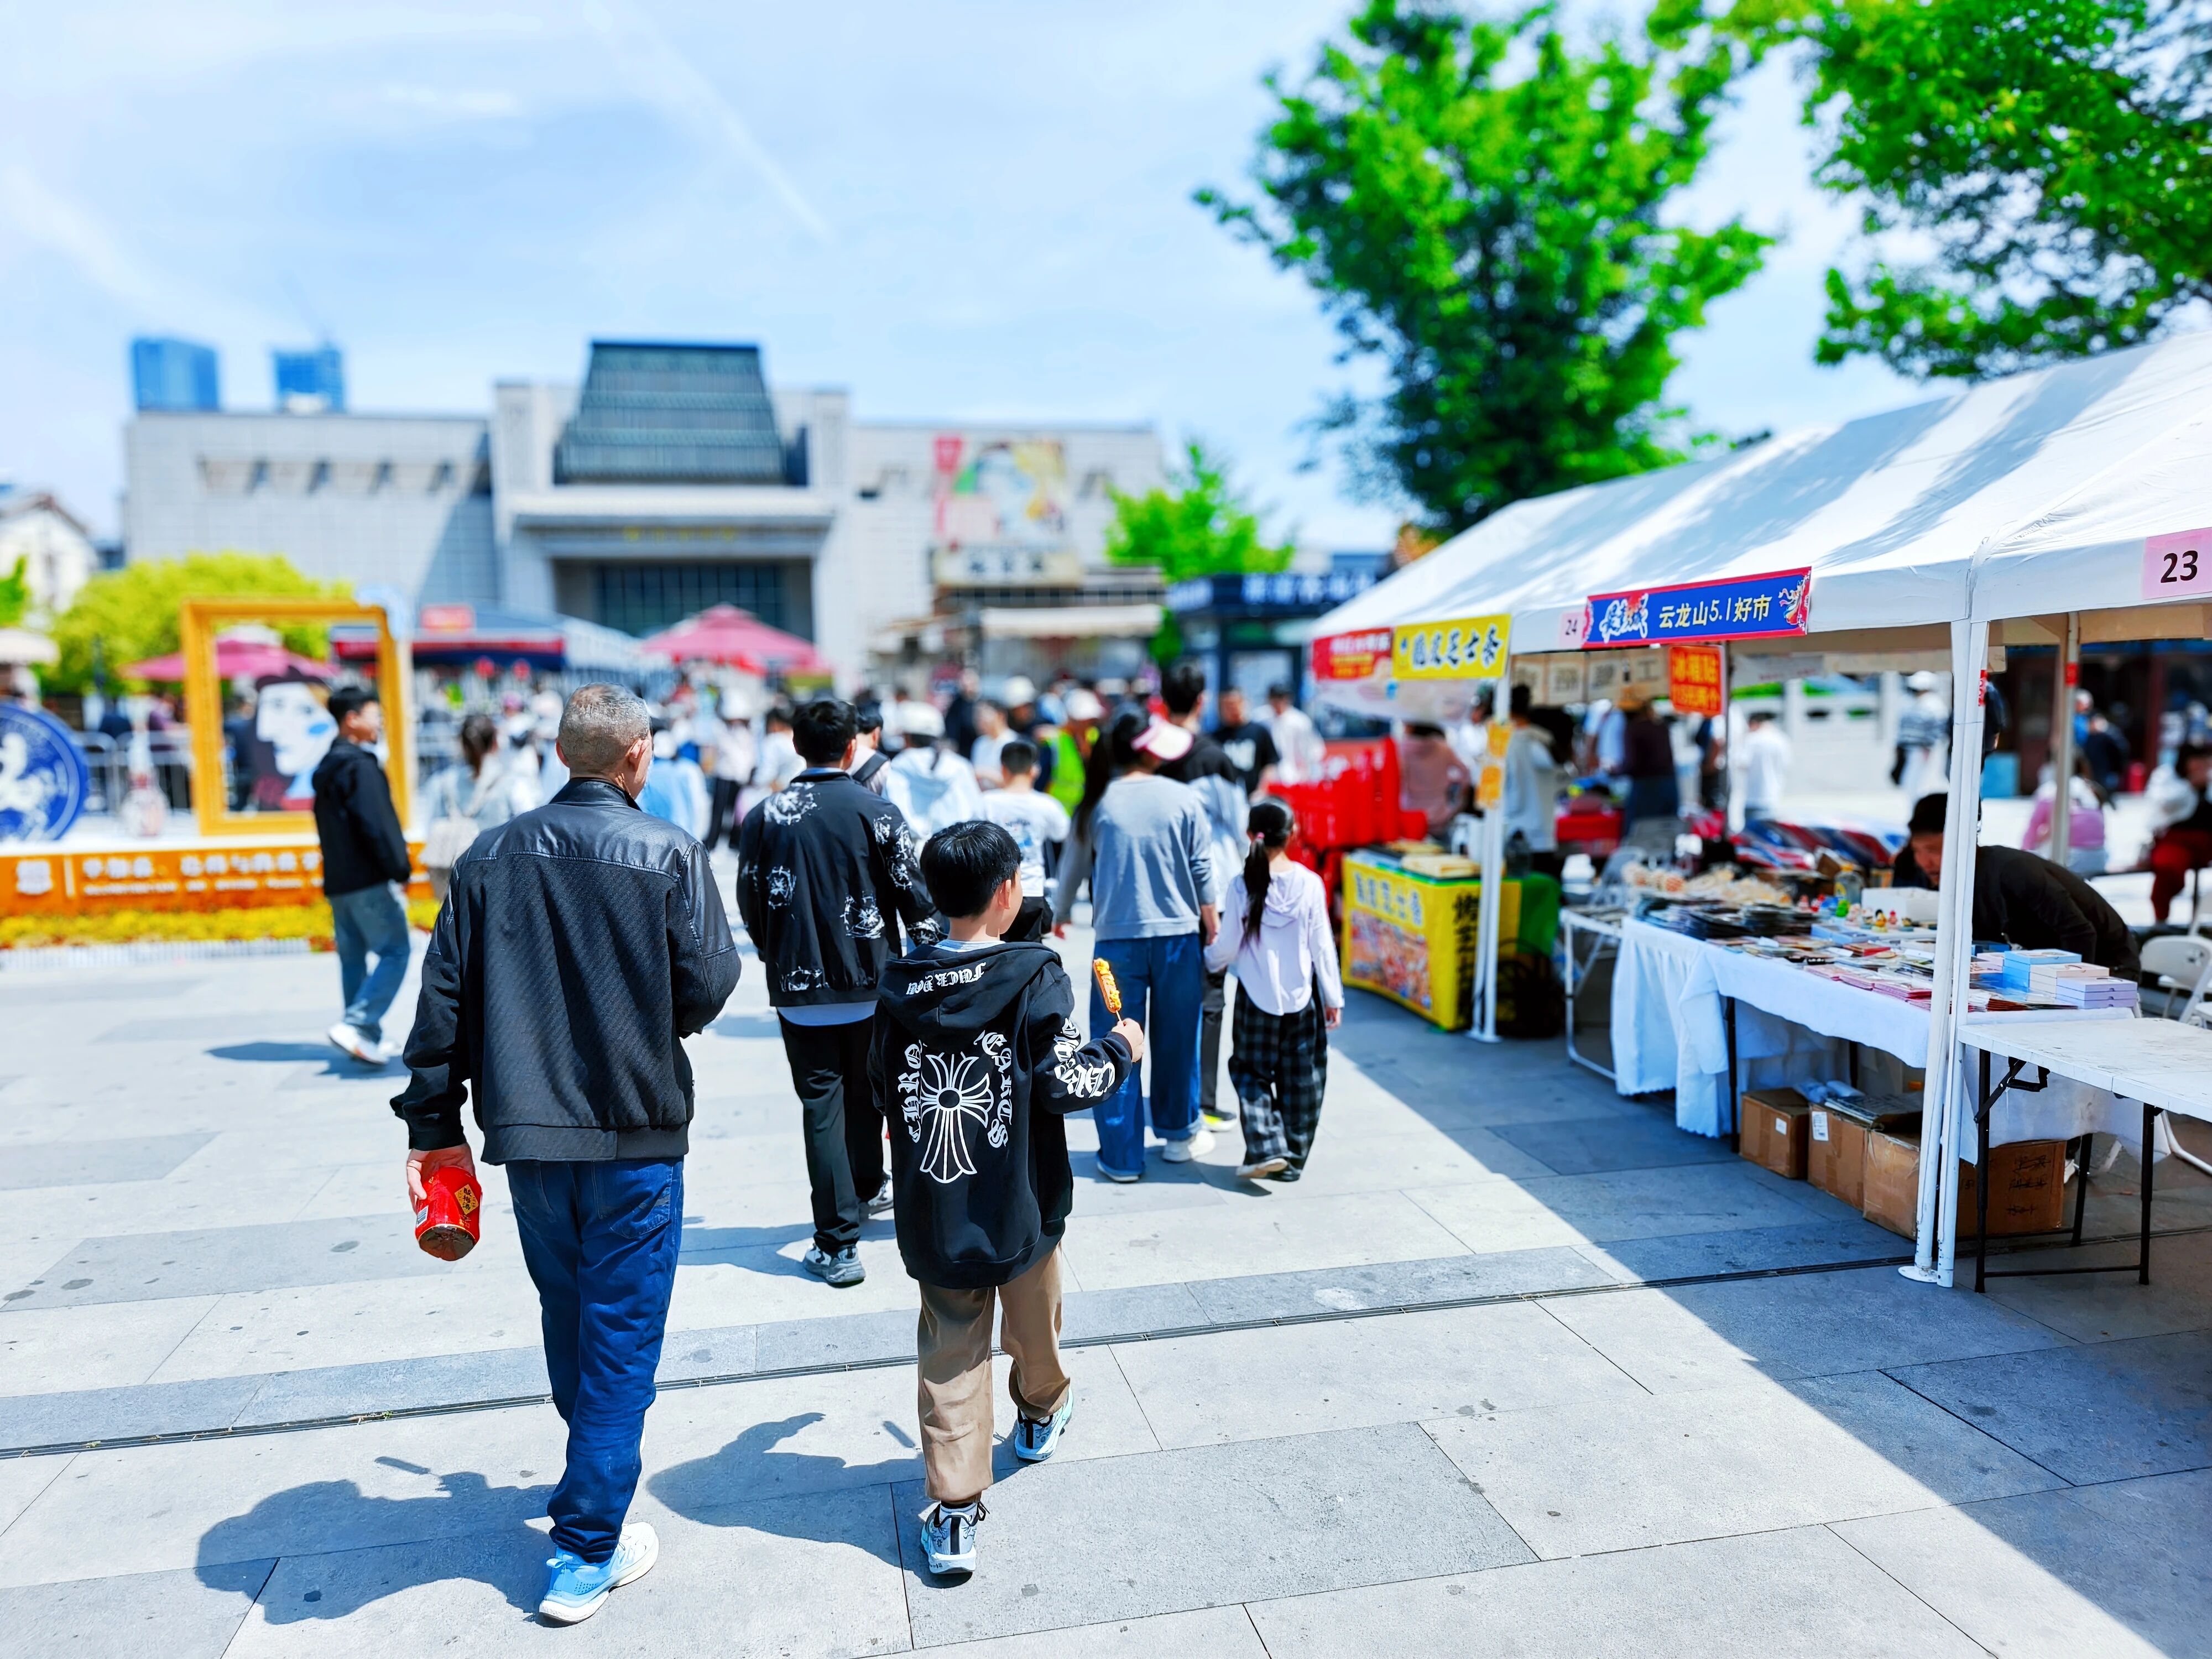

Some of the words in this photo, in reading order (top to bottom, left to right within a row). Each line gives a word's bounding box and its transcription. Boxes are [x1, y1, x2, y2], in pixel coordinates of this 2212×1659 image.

[2161, 550, 2198, 583] 23
[1565, 619, 1578, 635] 24
[1659, 594, 1772, 629] 云龙山5.1好市
